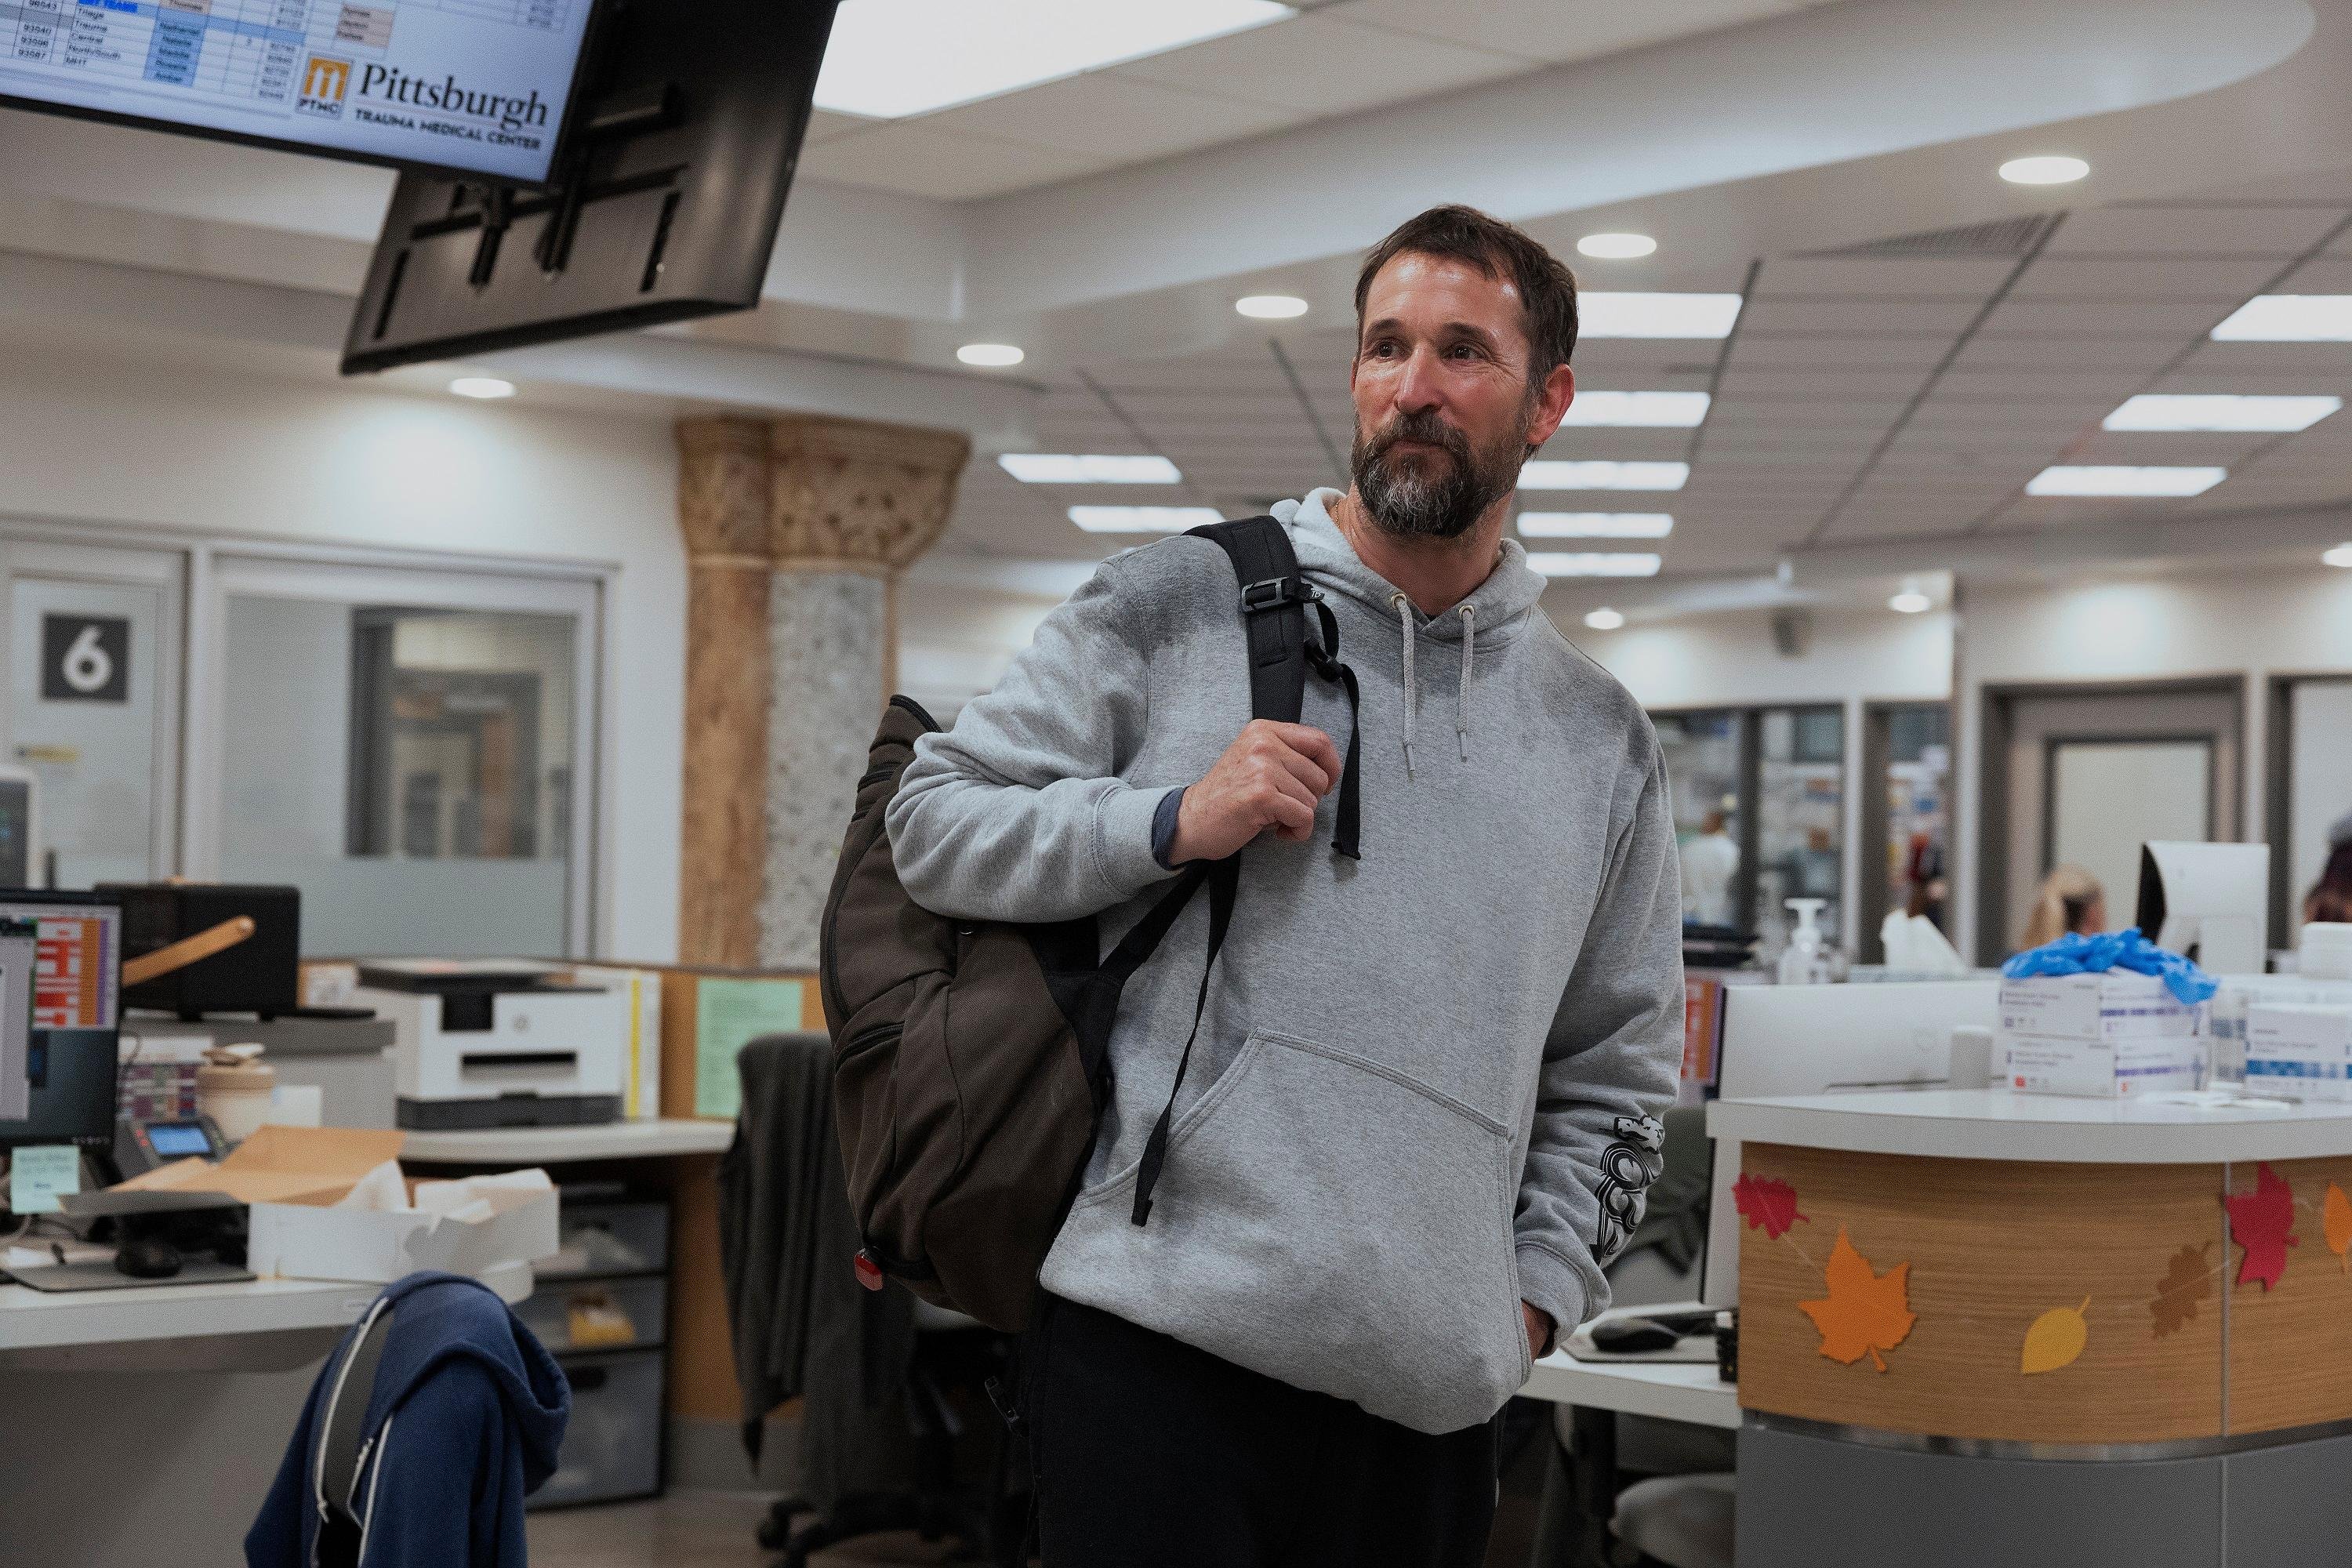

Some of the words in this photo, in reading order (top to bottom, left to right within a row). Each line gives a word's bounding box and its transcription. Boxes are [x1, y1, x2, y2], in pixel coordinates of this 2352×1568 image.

[78, 8, 104, 20] Triage
[358, 63, 548, 132] Pittsburgh
[356, 108, 416, 130] TRAUMA
[419, 121, 482, 141] MEDICAL
[486, 130, 541, 150] CENTER
[62, 625, 113, 692] 6
